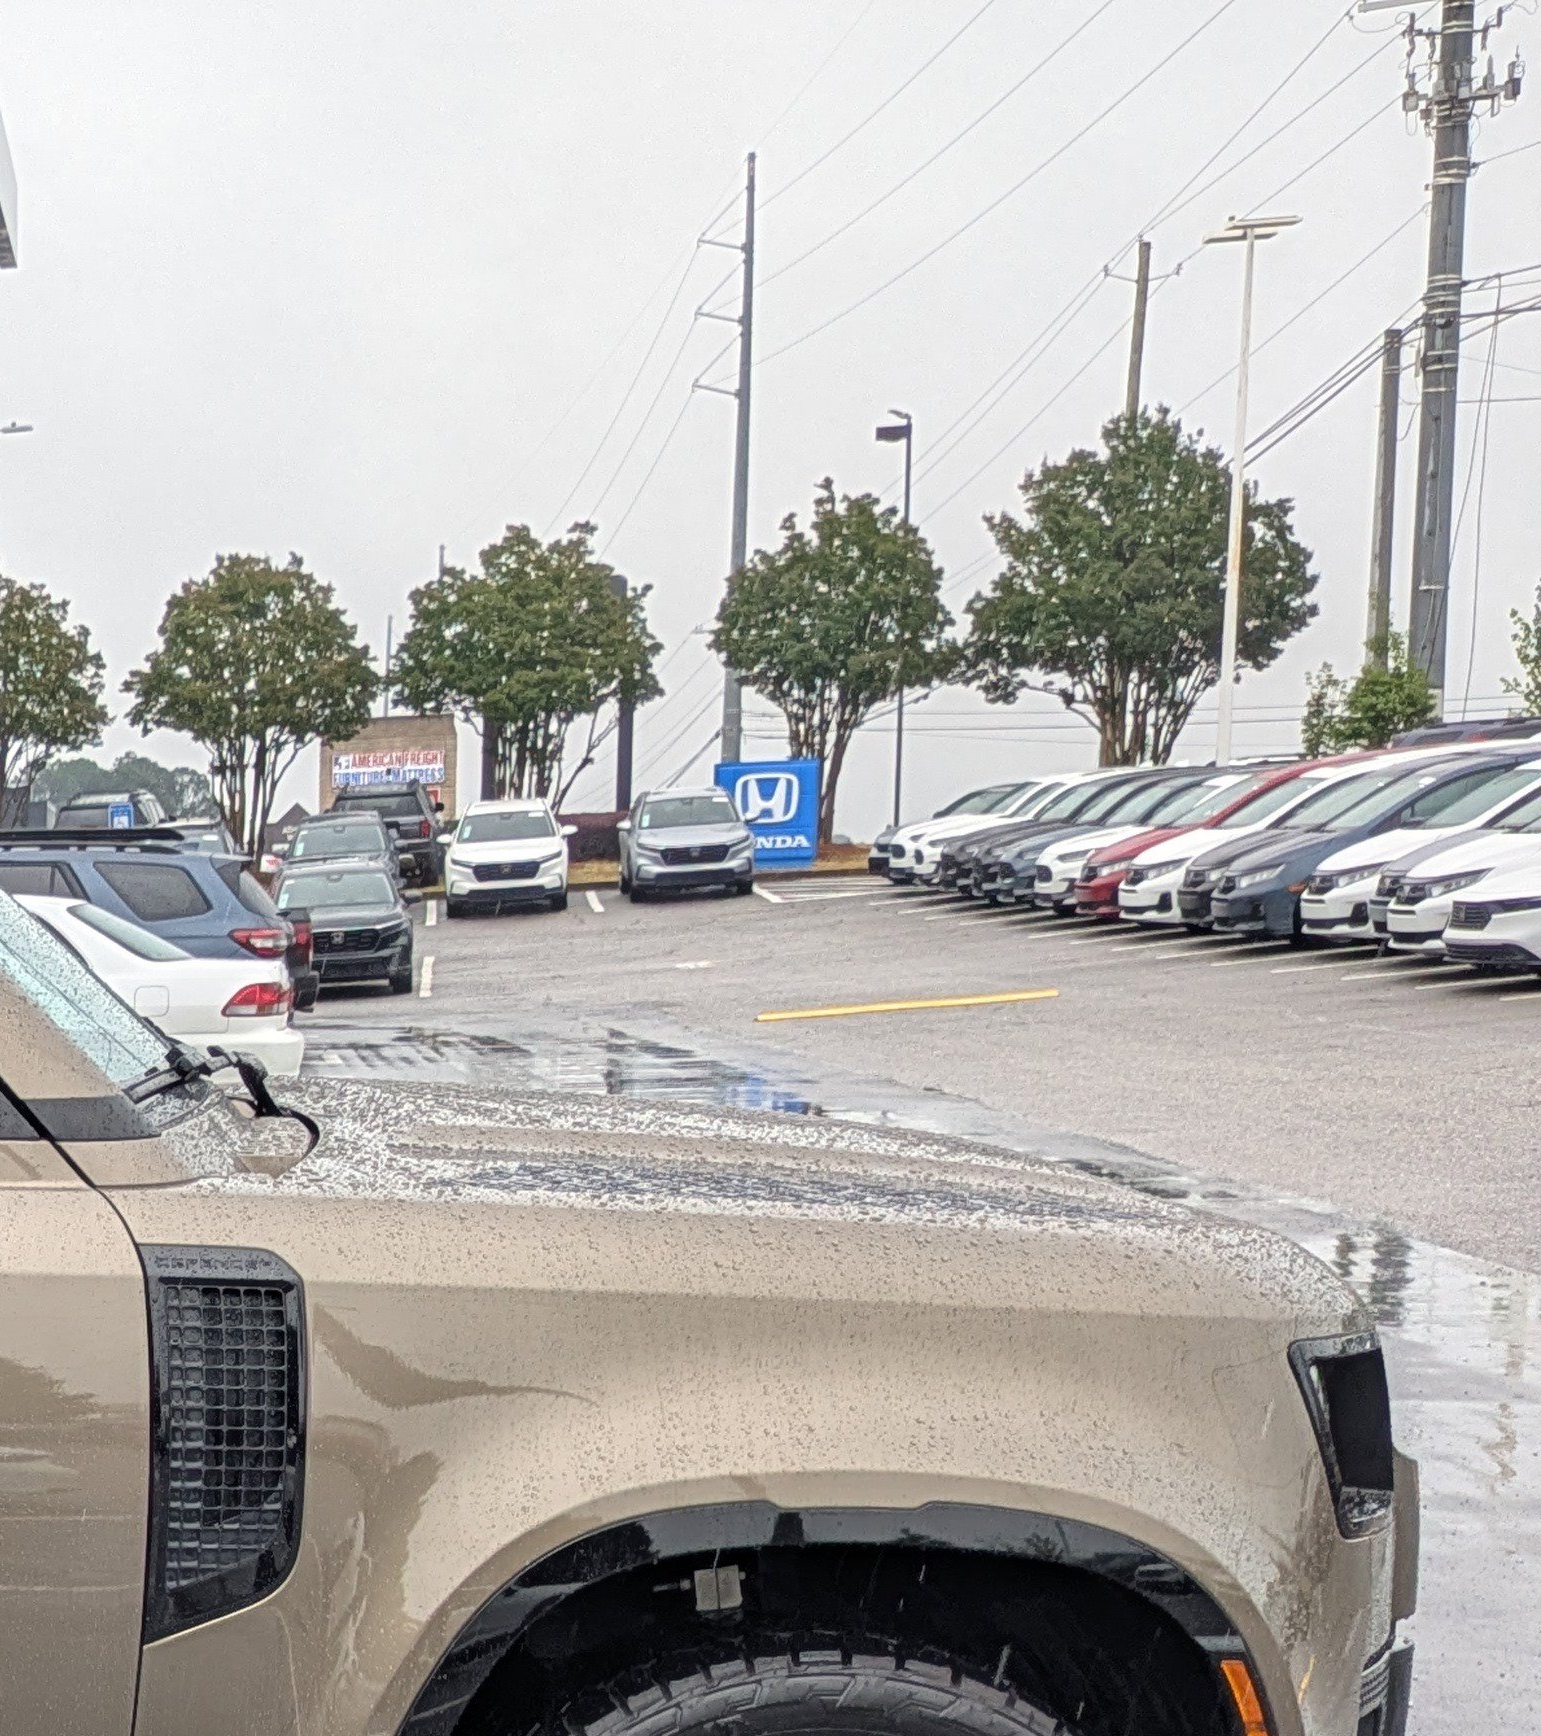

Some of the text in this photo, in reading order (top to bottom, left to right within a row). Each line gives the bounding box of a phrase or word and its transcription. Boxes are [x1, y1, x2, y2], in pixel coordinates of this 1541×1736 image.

[351, 752, 401, 768] AMERICAN
[403, 750, 445, 765] FREIGHT
[755, 835, 812, 849] NDA
